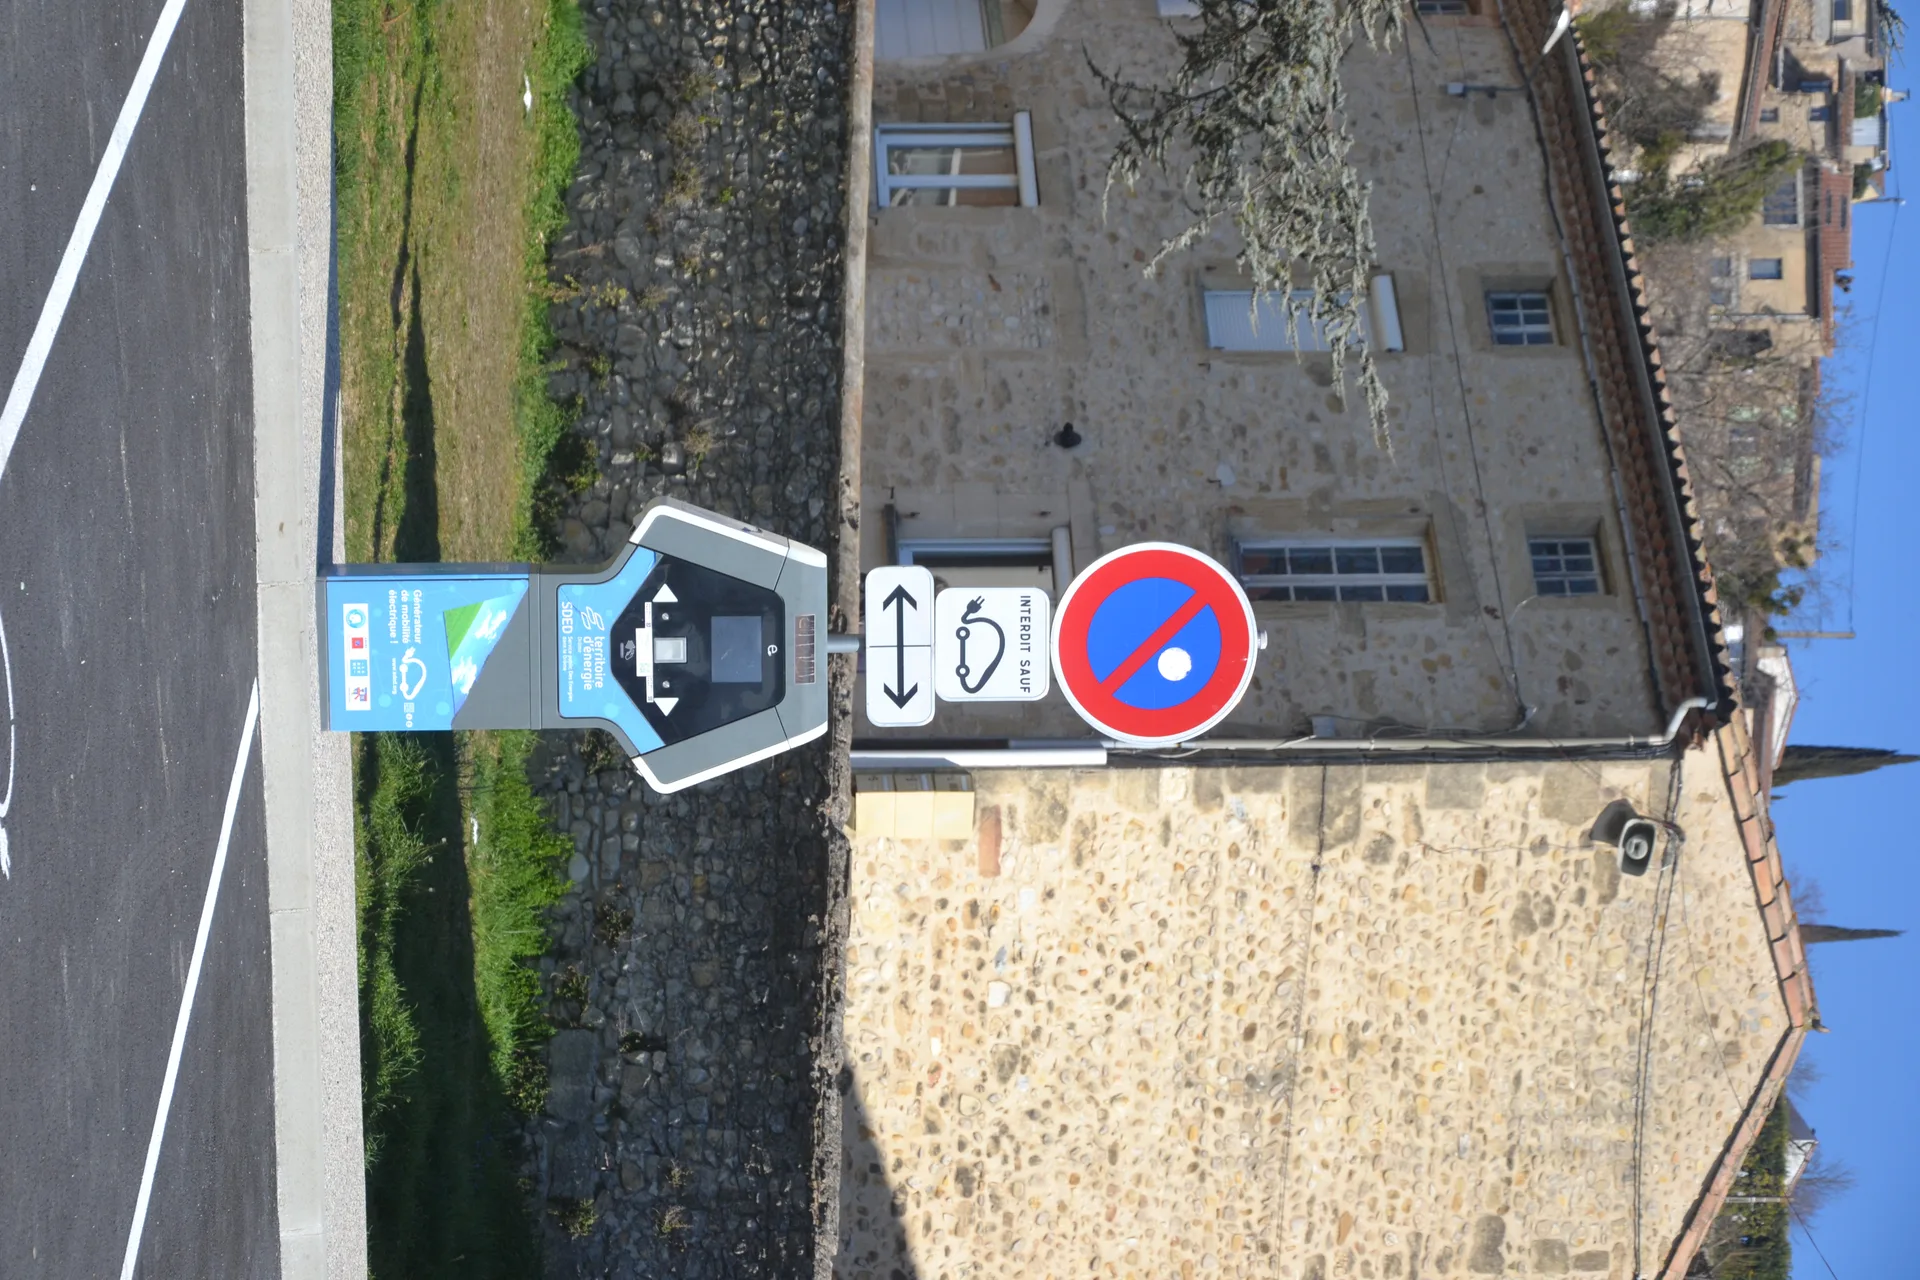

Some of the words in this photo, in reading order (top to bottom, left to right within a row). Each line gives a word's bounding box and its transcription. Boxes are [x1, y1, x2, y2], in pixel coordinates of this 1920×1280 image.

[388, 590, 398, 638] électrique
[401, 590, 410, 602] de
[413, 590, 422, 644] Générateur
[562, 602, 573, 634] SDED
[402, 604, 411, 644] mobilité
[1020, 596, 1031, 652] INTERDIT
[594, 636, 605, 688] territoire
[1020, 660, 1030, 694] SAUF
